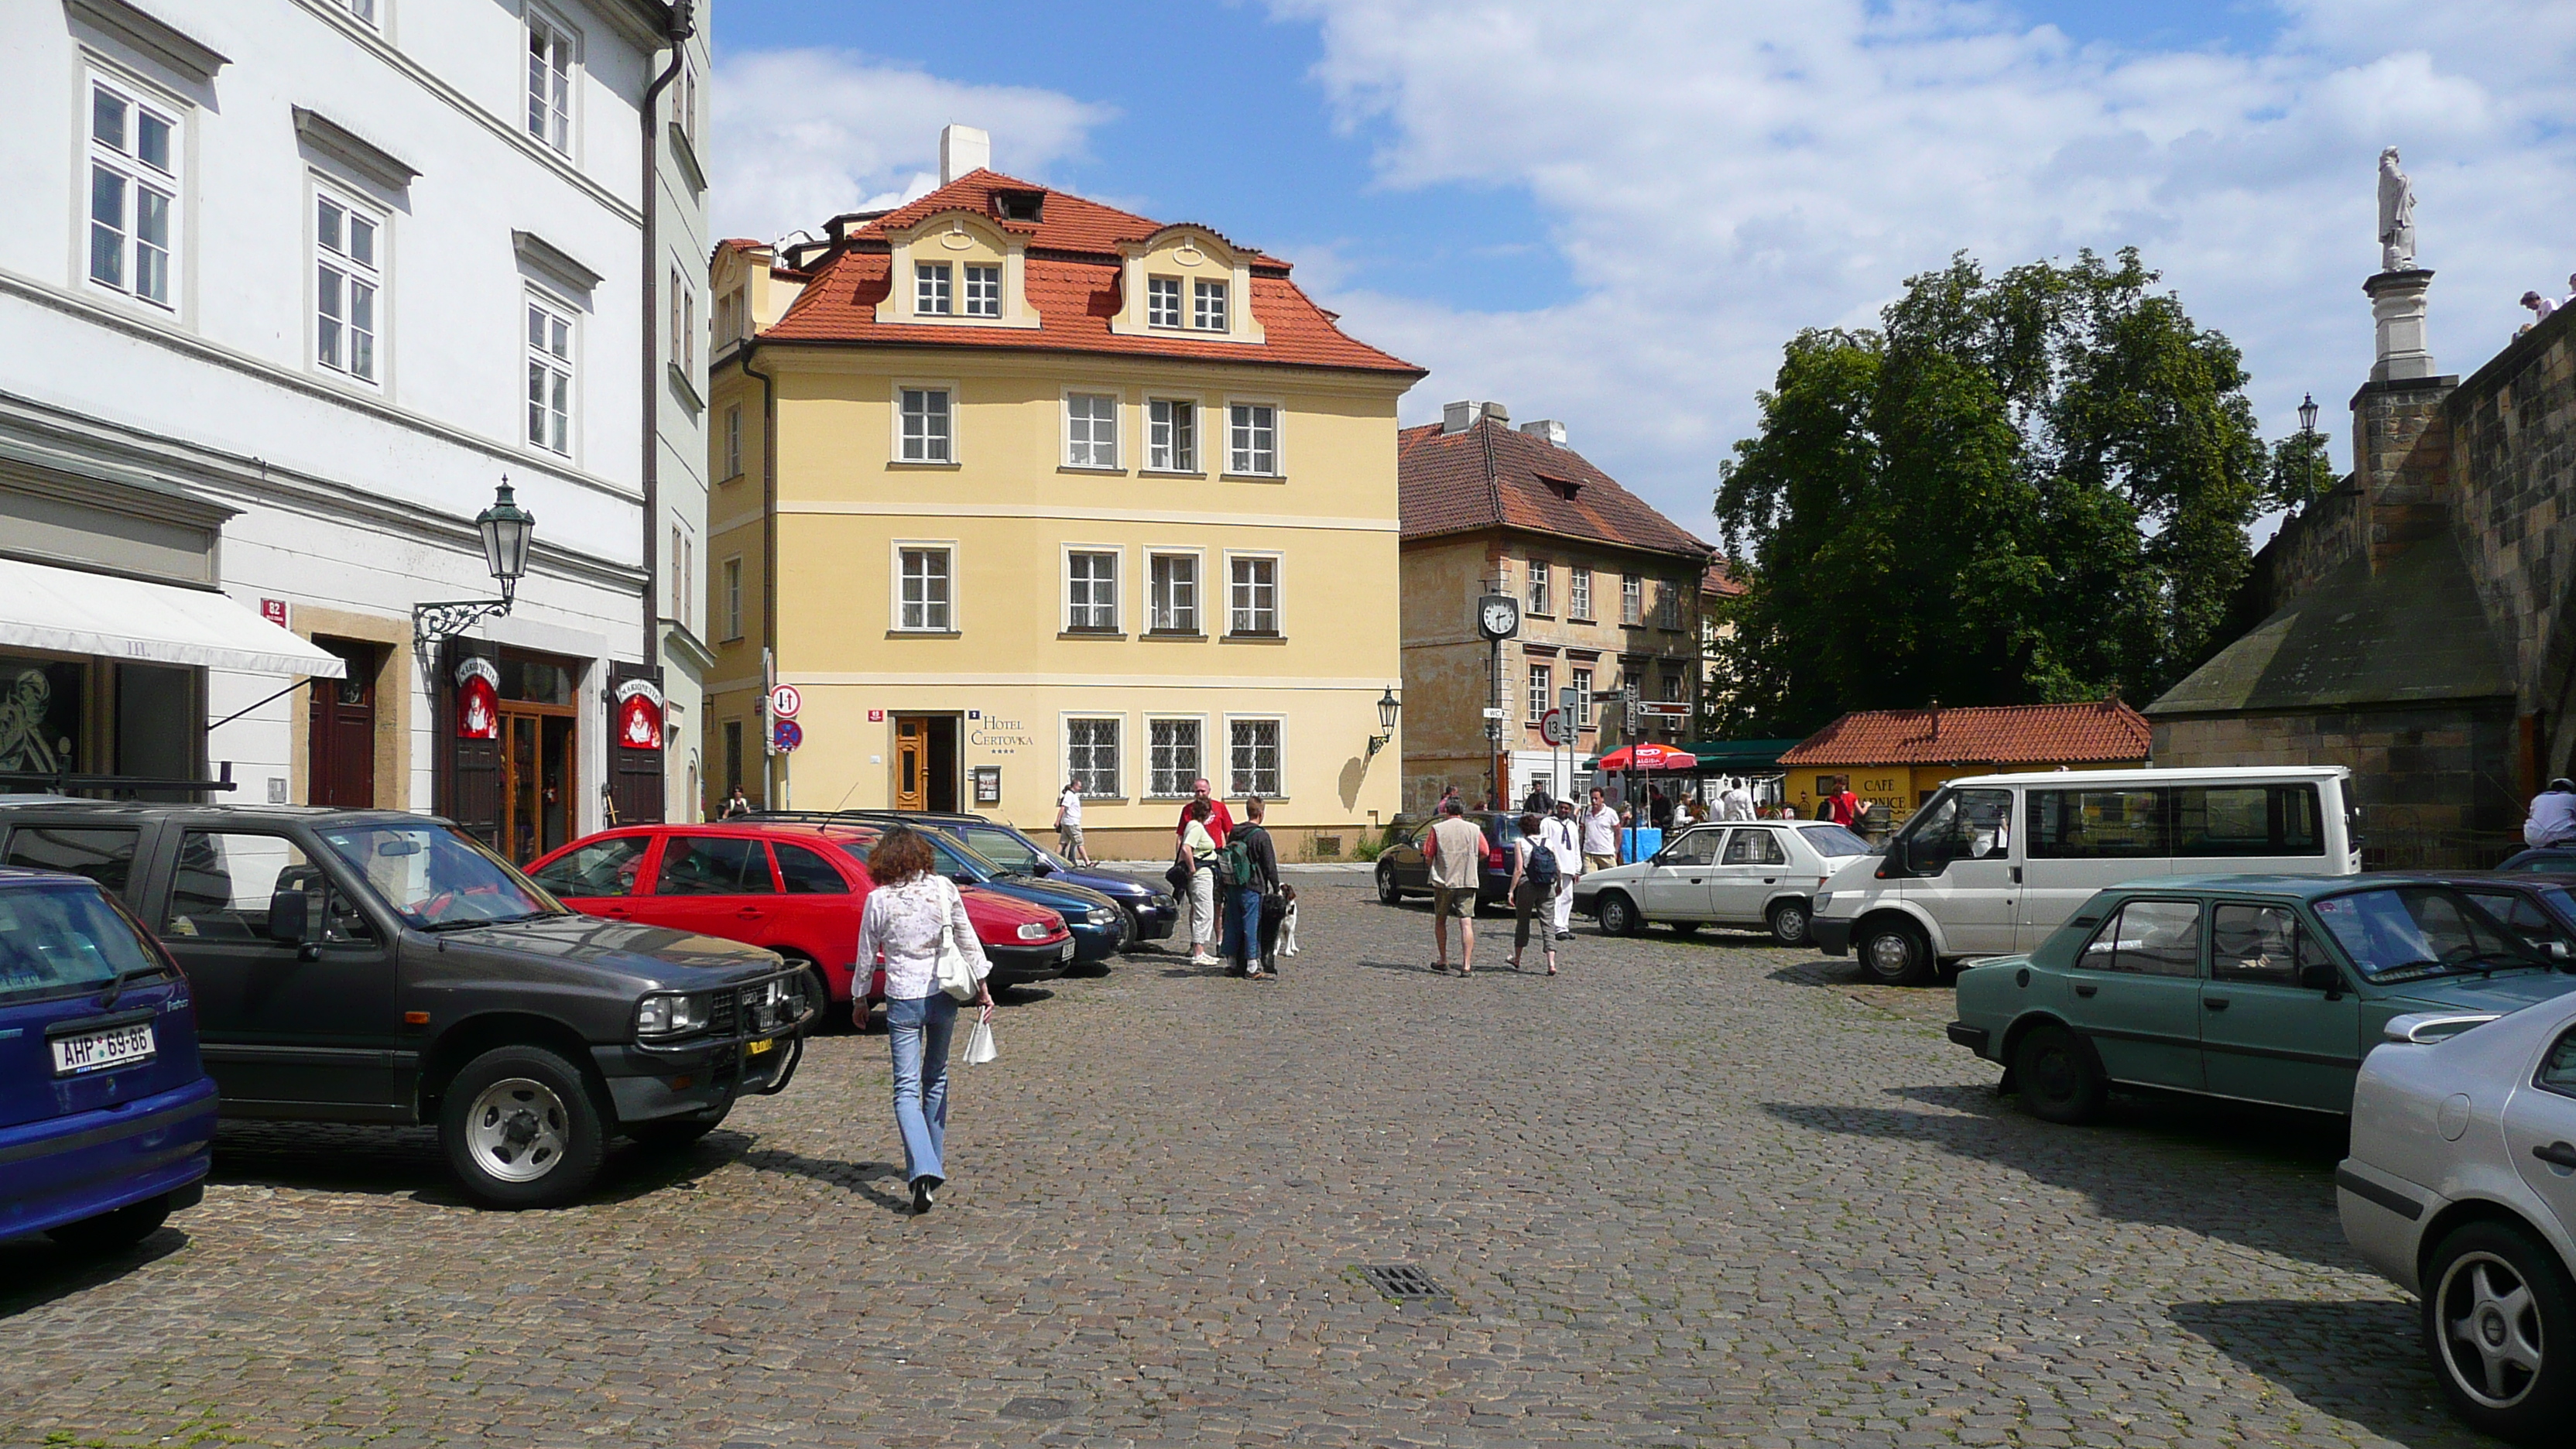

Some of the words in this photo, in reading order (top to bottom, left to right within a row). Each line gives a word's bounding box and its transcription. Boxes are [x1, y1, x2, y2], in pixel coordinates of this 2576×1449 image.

[269, 601, 280, 615] 82
[983, 715, 1025, 730] HOTEL
[1547, 721, 1558, 735] 13
[971, 729, 1034, 745] ČERTOVKA
[1863, 779, 1895, 792] CAFE
[1858, 796, 1906, 809] ADNICE
[64, 1036, 94, 1067] AHP
[106, 1026, 148, 1057] 69-86
